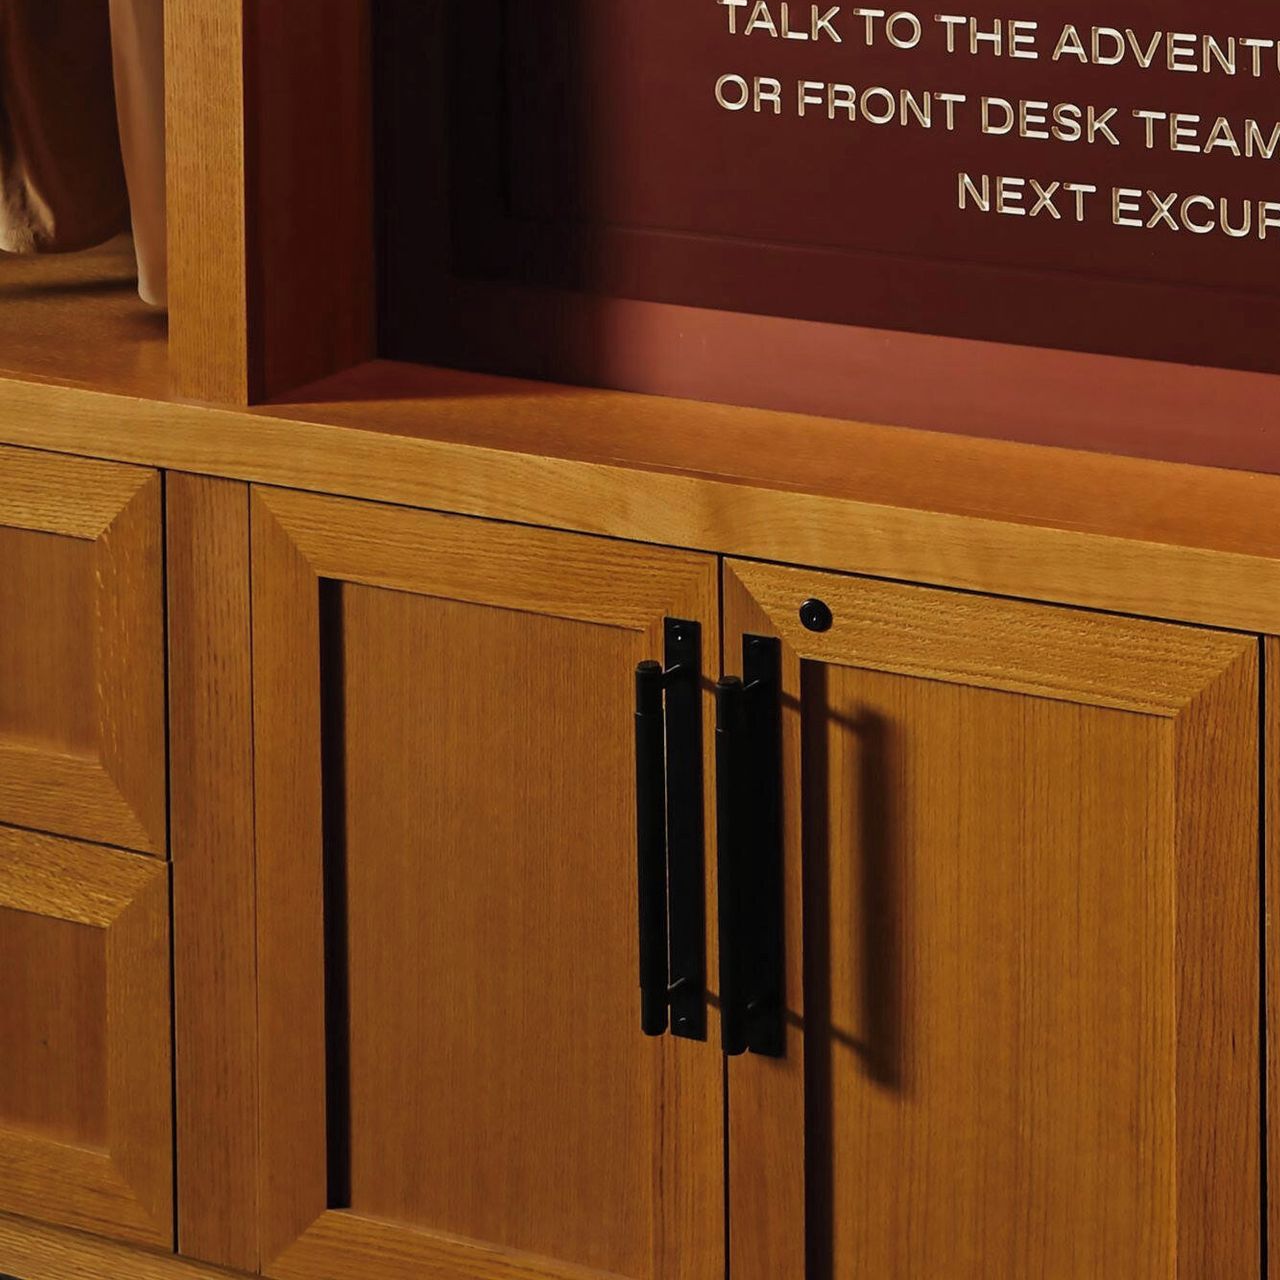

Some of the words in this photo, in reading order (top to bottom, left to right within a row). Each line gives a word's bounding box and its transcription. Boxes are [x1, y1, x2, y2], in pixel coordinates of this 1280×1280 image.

[853, 8, 921, 49] TO
[934, 15, 1038, 59] THE
[715, 74, 781, 114] OR
[798, 81, 966, 130] FRONT
[981, 97, 1120, 145] DESK
[958, 173, 1097, 221] NEXT
